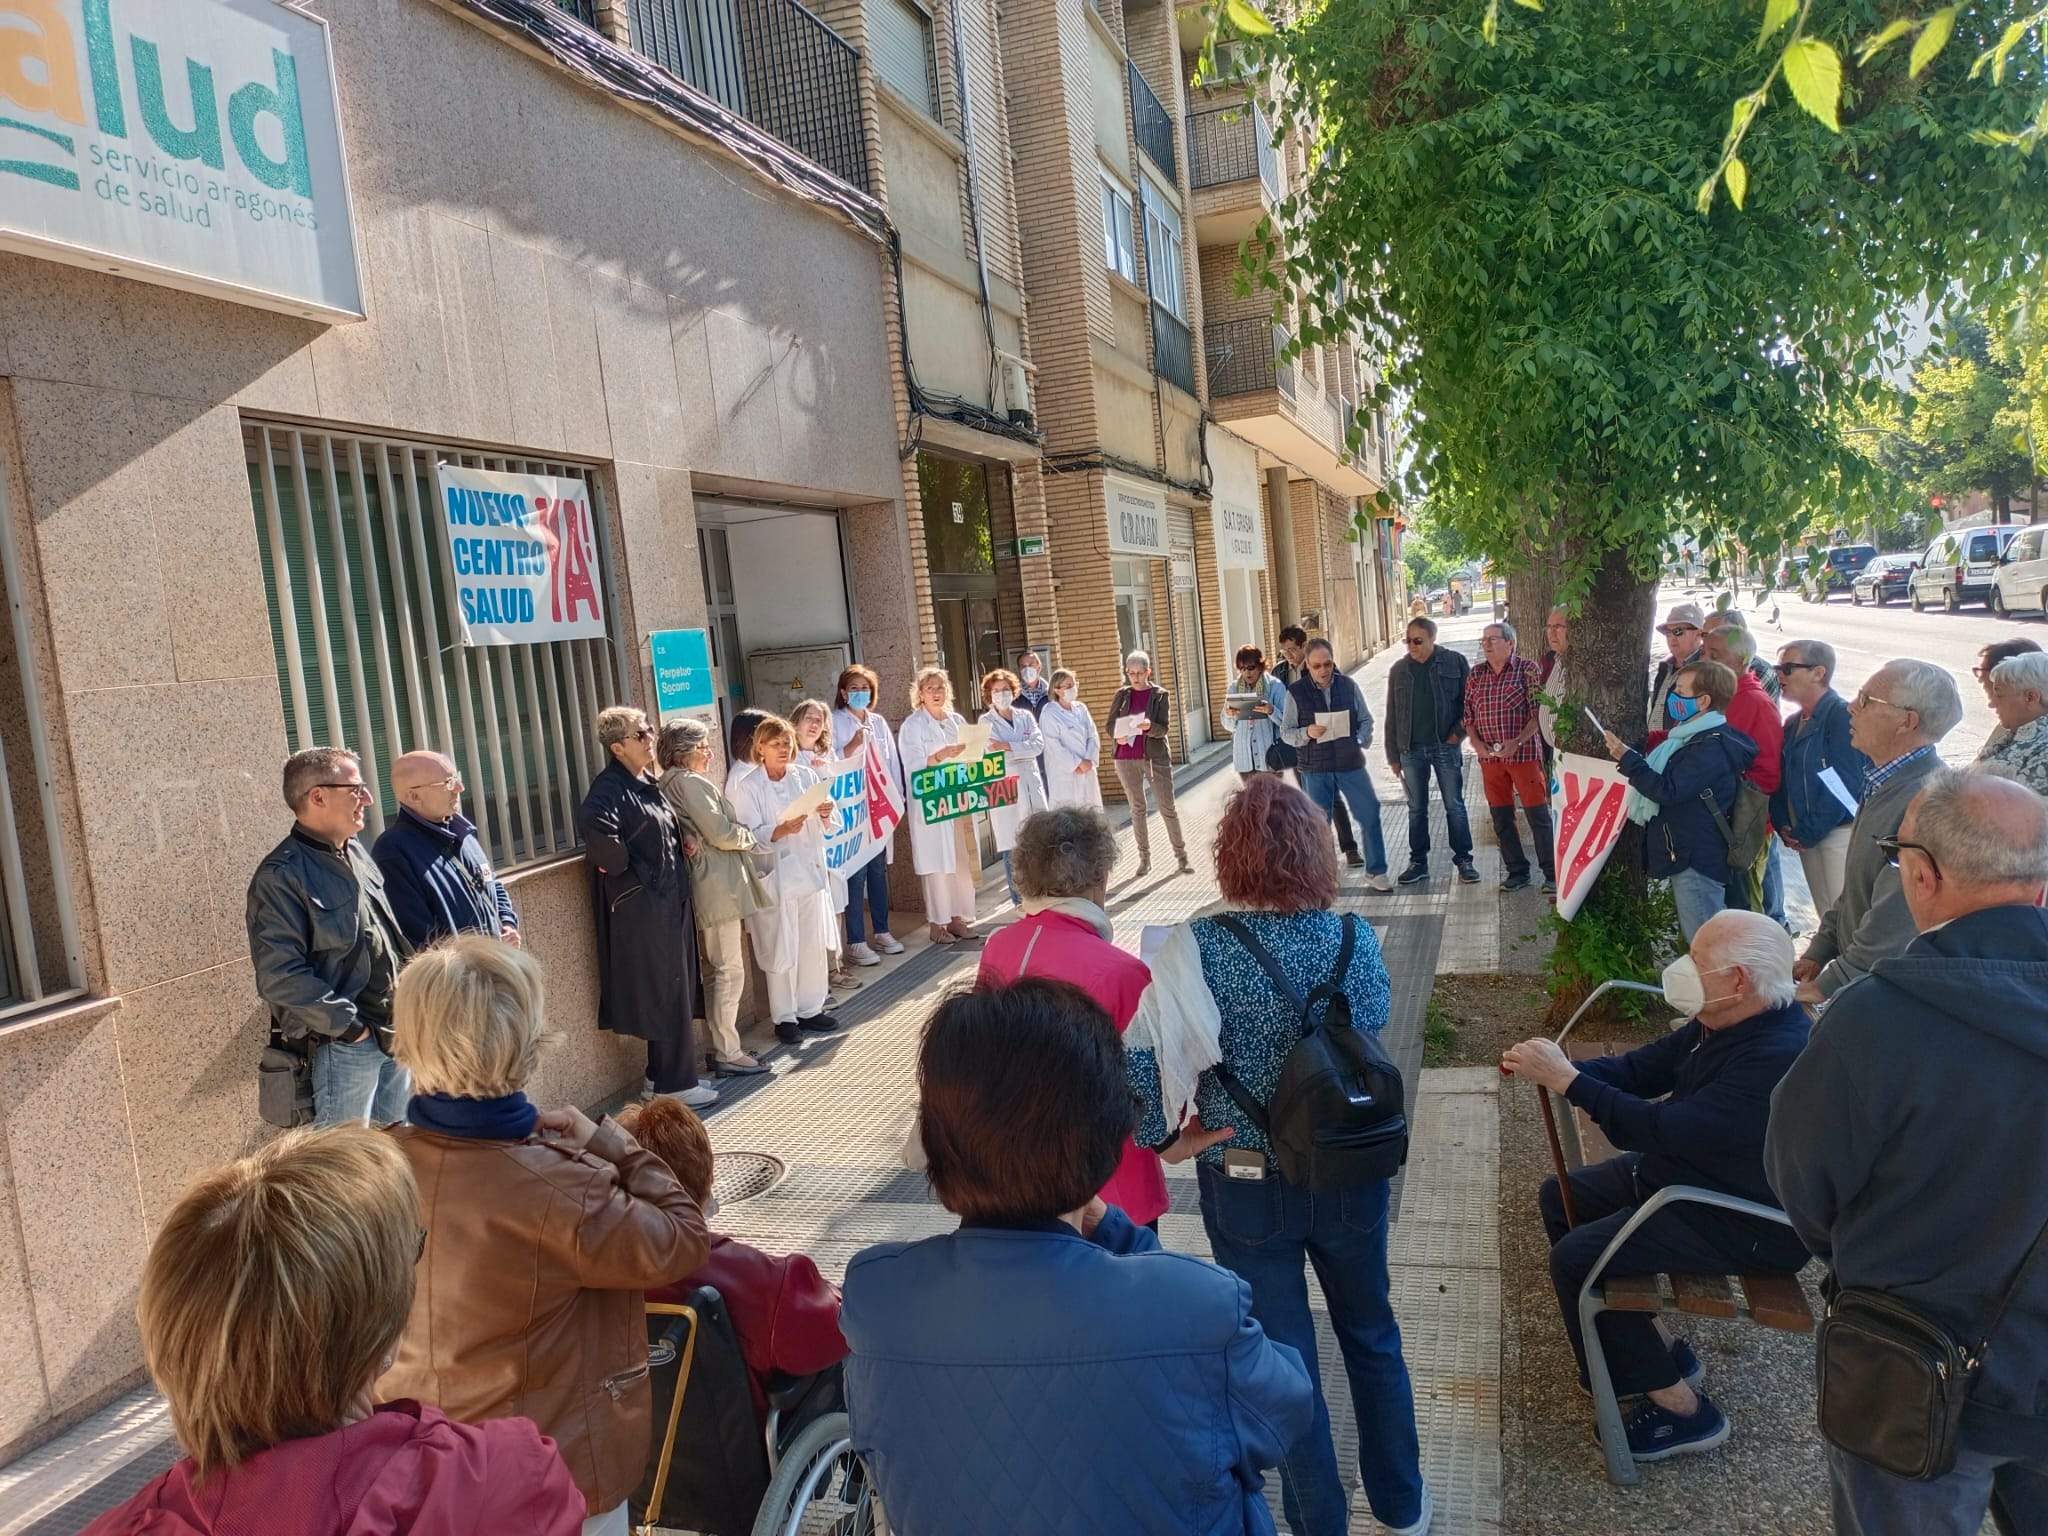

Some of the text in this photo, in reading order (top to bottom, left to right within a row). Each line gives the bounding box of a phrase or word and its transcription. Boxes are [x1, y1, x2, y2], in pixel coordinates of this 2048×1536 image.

[89, 143, 319, 231] servicio aragonés
[95, 173, 211, 228] de salud
[447, 487, 528, 528] NUEVO
[1120, 511, 1158, 548] GRASAN
[453, 537, 546, 576] CENTRO
[460, 587, 534, 625] SALUD
[659, 666, 691, 679] Perpetuo
[661, 681, 690, 694] Socorro
[829, 768, 865, 800] UEV
[913, 755, 1004, 796] CENTRO DE
[925, 790, 979, 821] SALUD
[825, 831, 863, 869] SALUD
